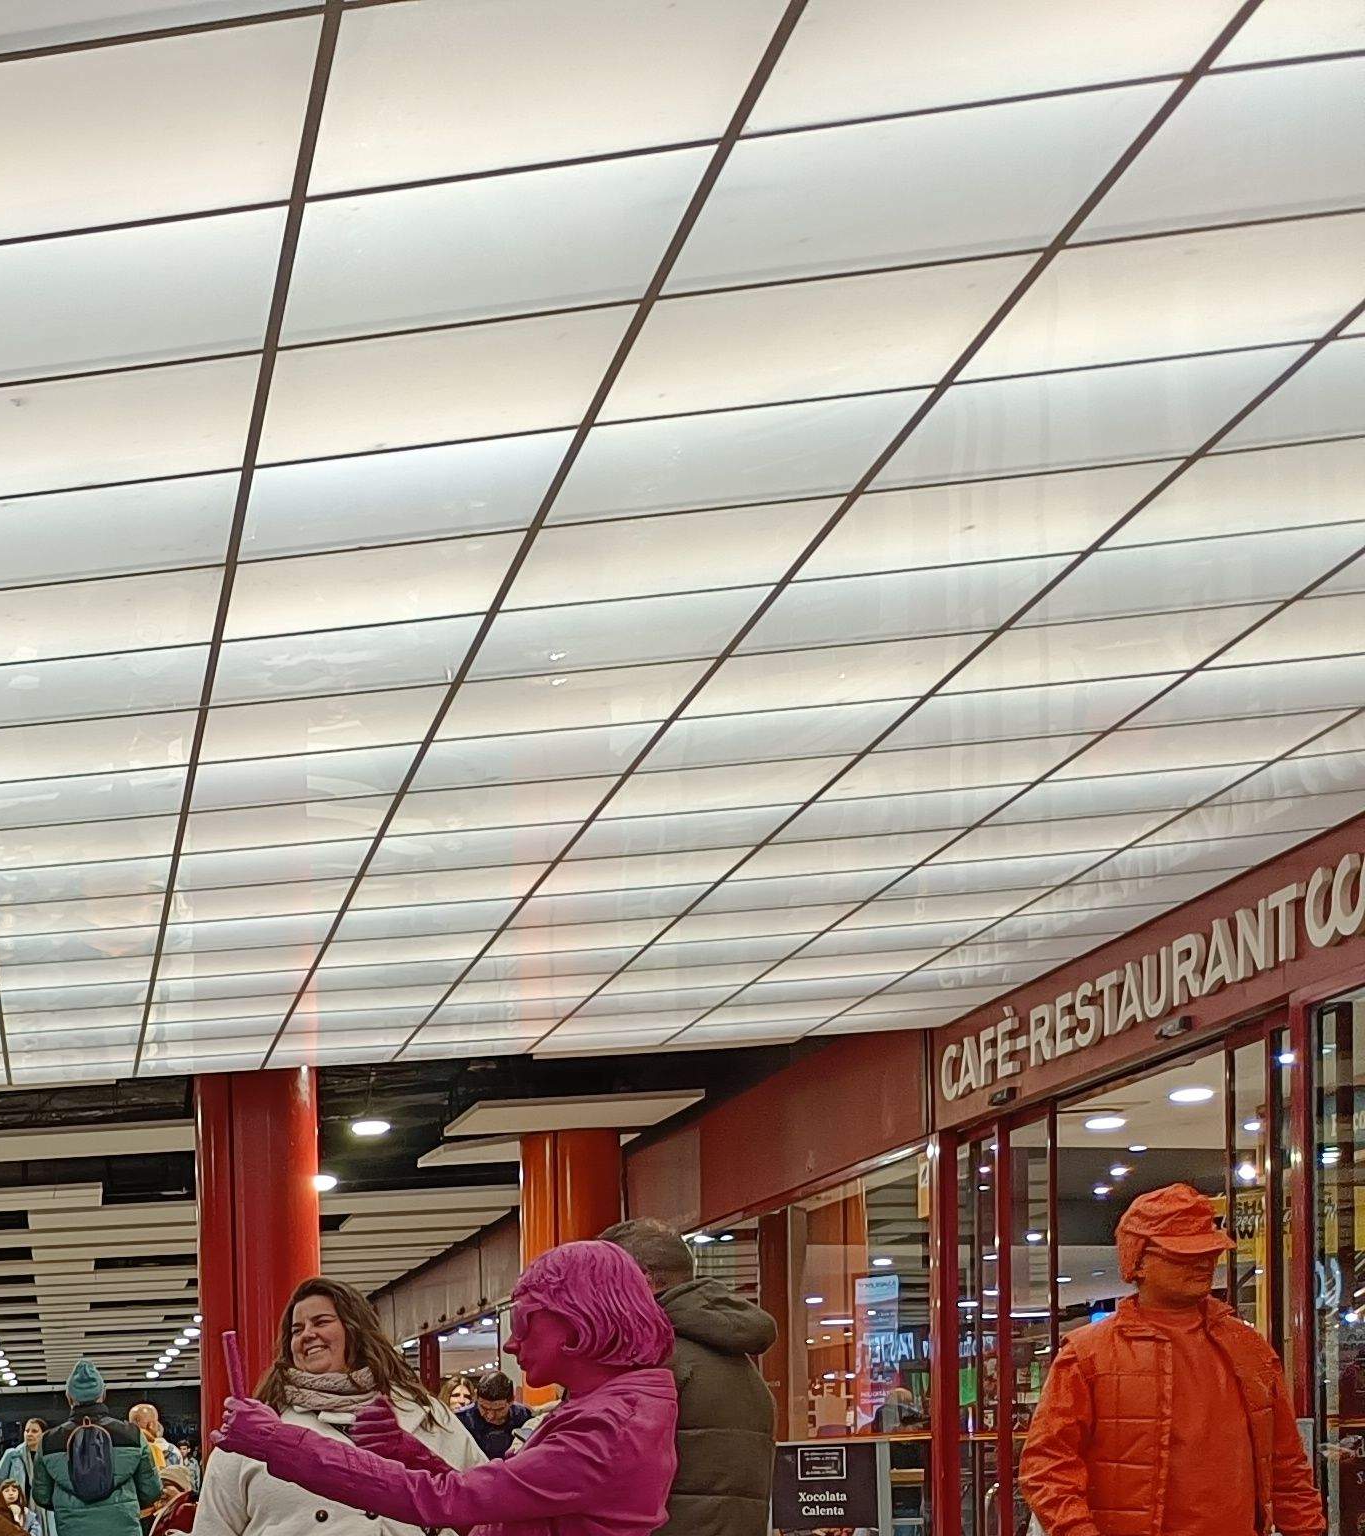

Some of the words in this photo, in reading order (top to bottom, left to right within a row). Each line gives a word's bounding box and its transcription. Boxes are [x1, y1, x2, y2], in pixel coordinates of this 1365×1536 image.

[941, 882, 1306, 1102] CAFÈ-RESTAURANT
[1305, 852, 1365, 948] CC
[798, 1490, 848, 1502] Xocolata
[801, 1505, 845, 1516] Calenta
